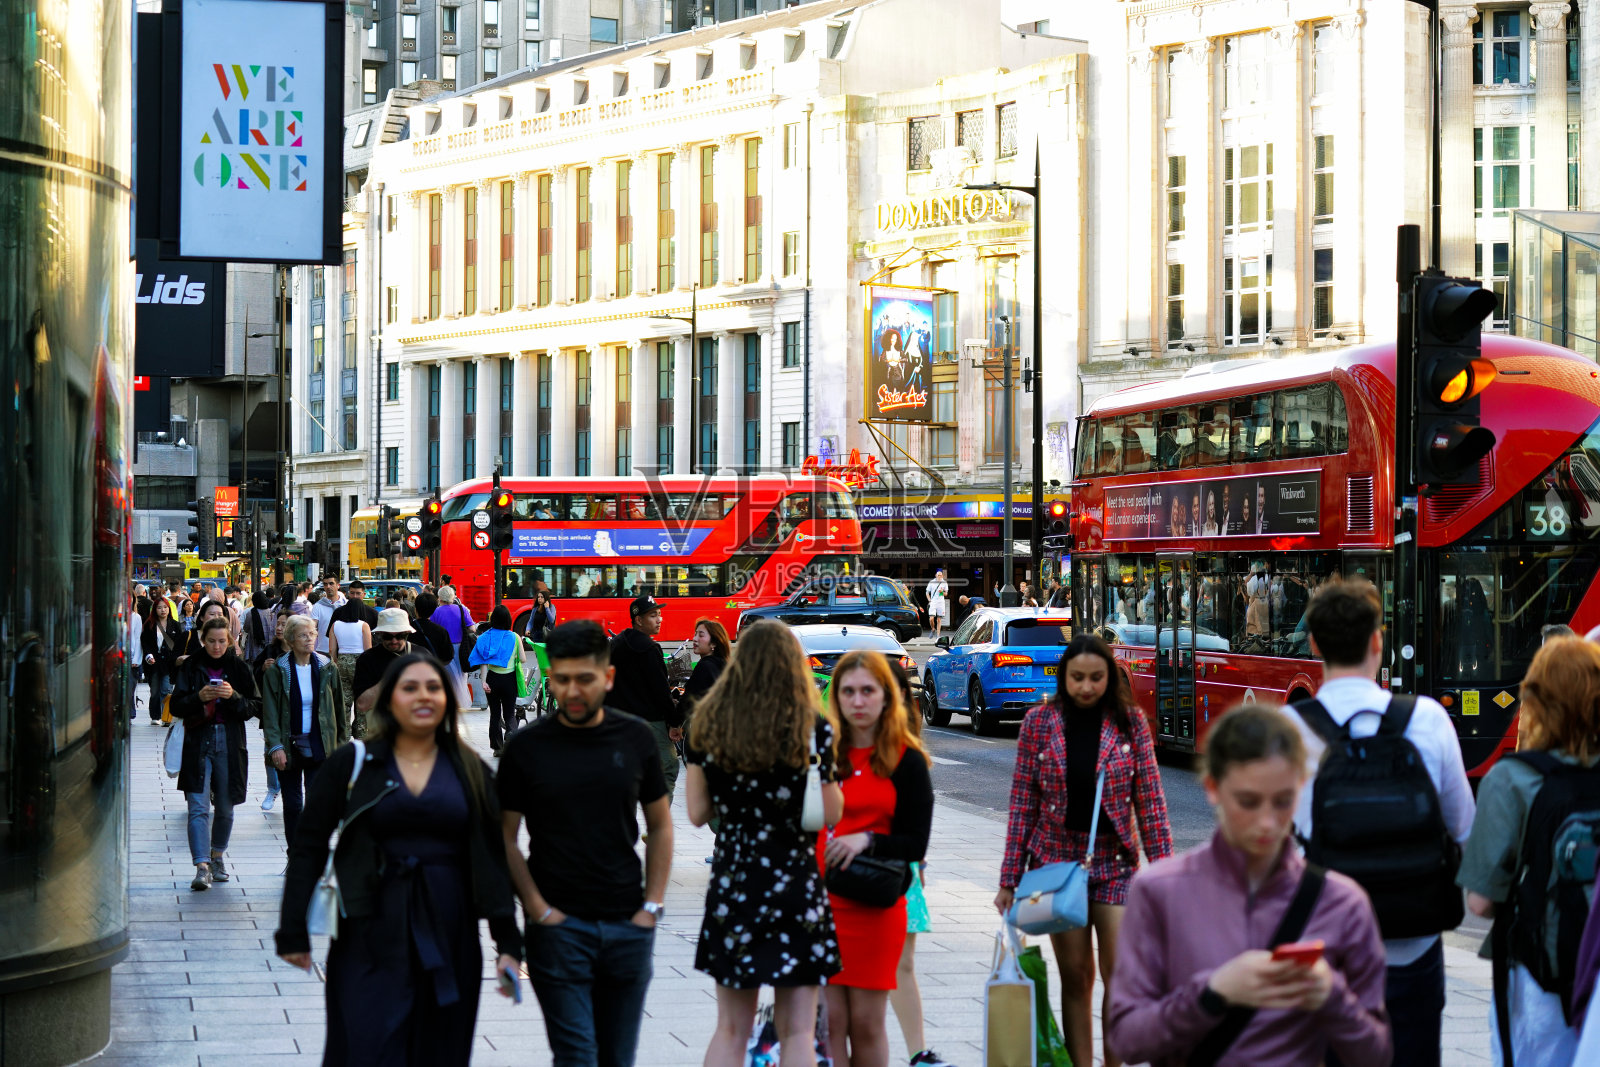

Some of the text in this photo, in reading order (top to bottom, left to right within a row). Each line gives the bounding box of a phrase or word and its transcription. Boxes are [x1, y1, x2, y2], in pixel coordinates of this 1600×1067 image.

[212, 63, 295, 103] WE
[199, 106, 303, 148] ARE
[193, 152, 307, 192] ONE
[875, 190, 1014, 232] DOMINION
[135, 273, 206, 305] Lids
[876, 383, 929, 409] Sister Act
[863, 506, 899, 517] COMEDY
[900, 505, 938, 517] RETURNS
[1106, 491, 1163, 510] Meet the real people with
[1106, 512, 1115, 525] real
[1114, 511, 1132, 526] London
[1529, 505, 1566, 537] 38
